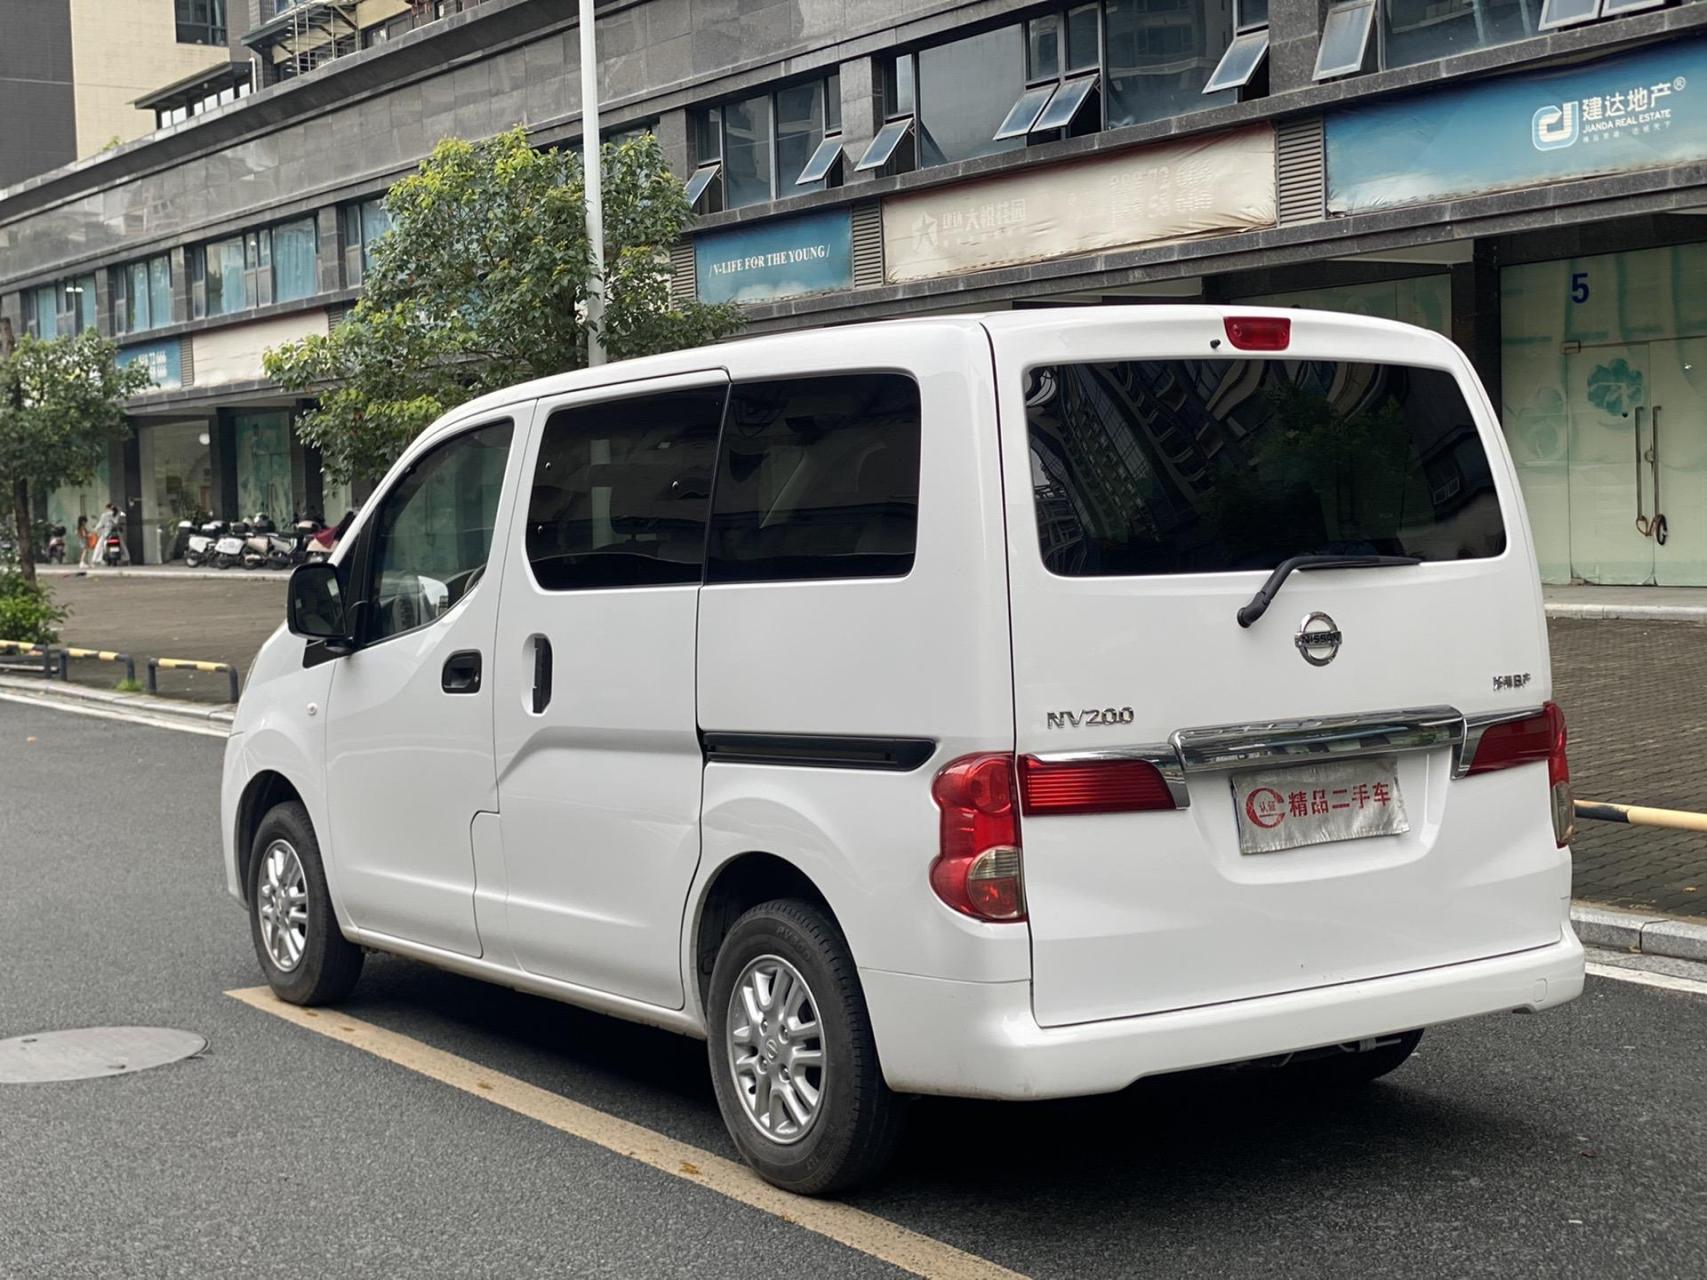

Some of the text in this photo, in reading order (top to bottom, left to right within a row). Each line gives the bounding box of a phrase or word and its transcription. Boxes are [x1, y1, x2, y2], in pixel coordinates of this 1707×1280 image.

[1582, 83, 1672, 121] 建达地产
[1583, 121, 1614, 134] JIANDA
[1615, 116, 1638, 128] REAL
[1638, 108, 1672, 123] ESTATE
[745, 255, 764, 270] FOR
[767, 251, 787, 266] THE
[1571, 272, 1590, 304] 5
[1046, 706, 1135, 729] NV200
[1288, 782, 1392, 817] 精品二手车
